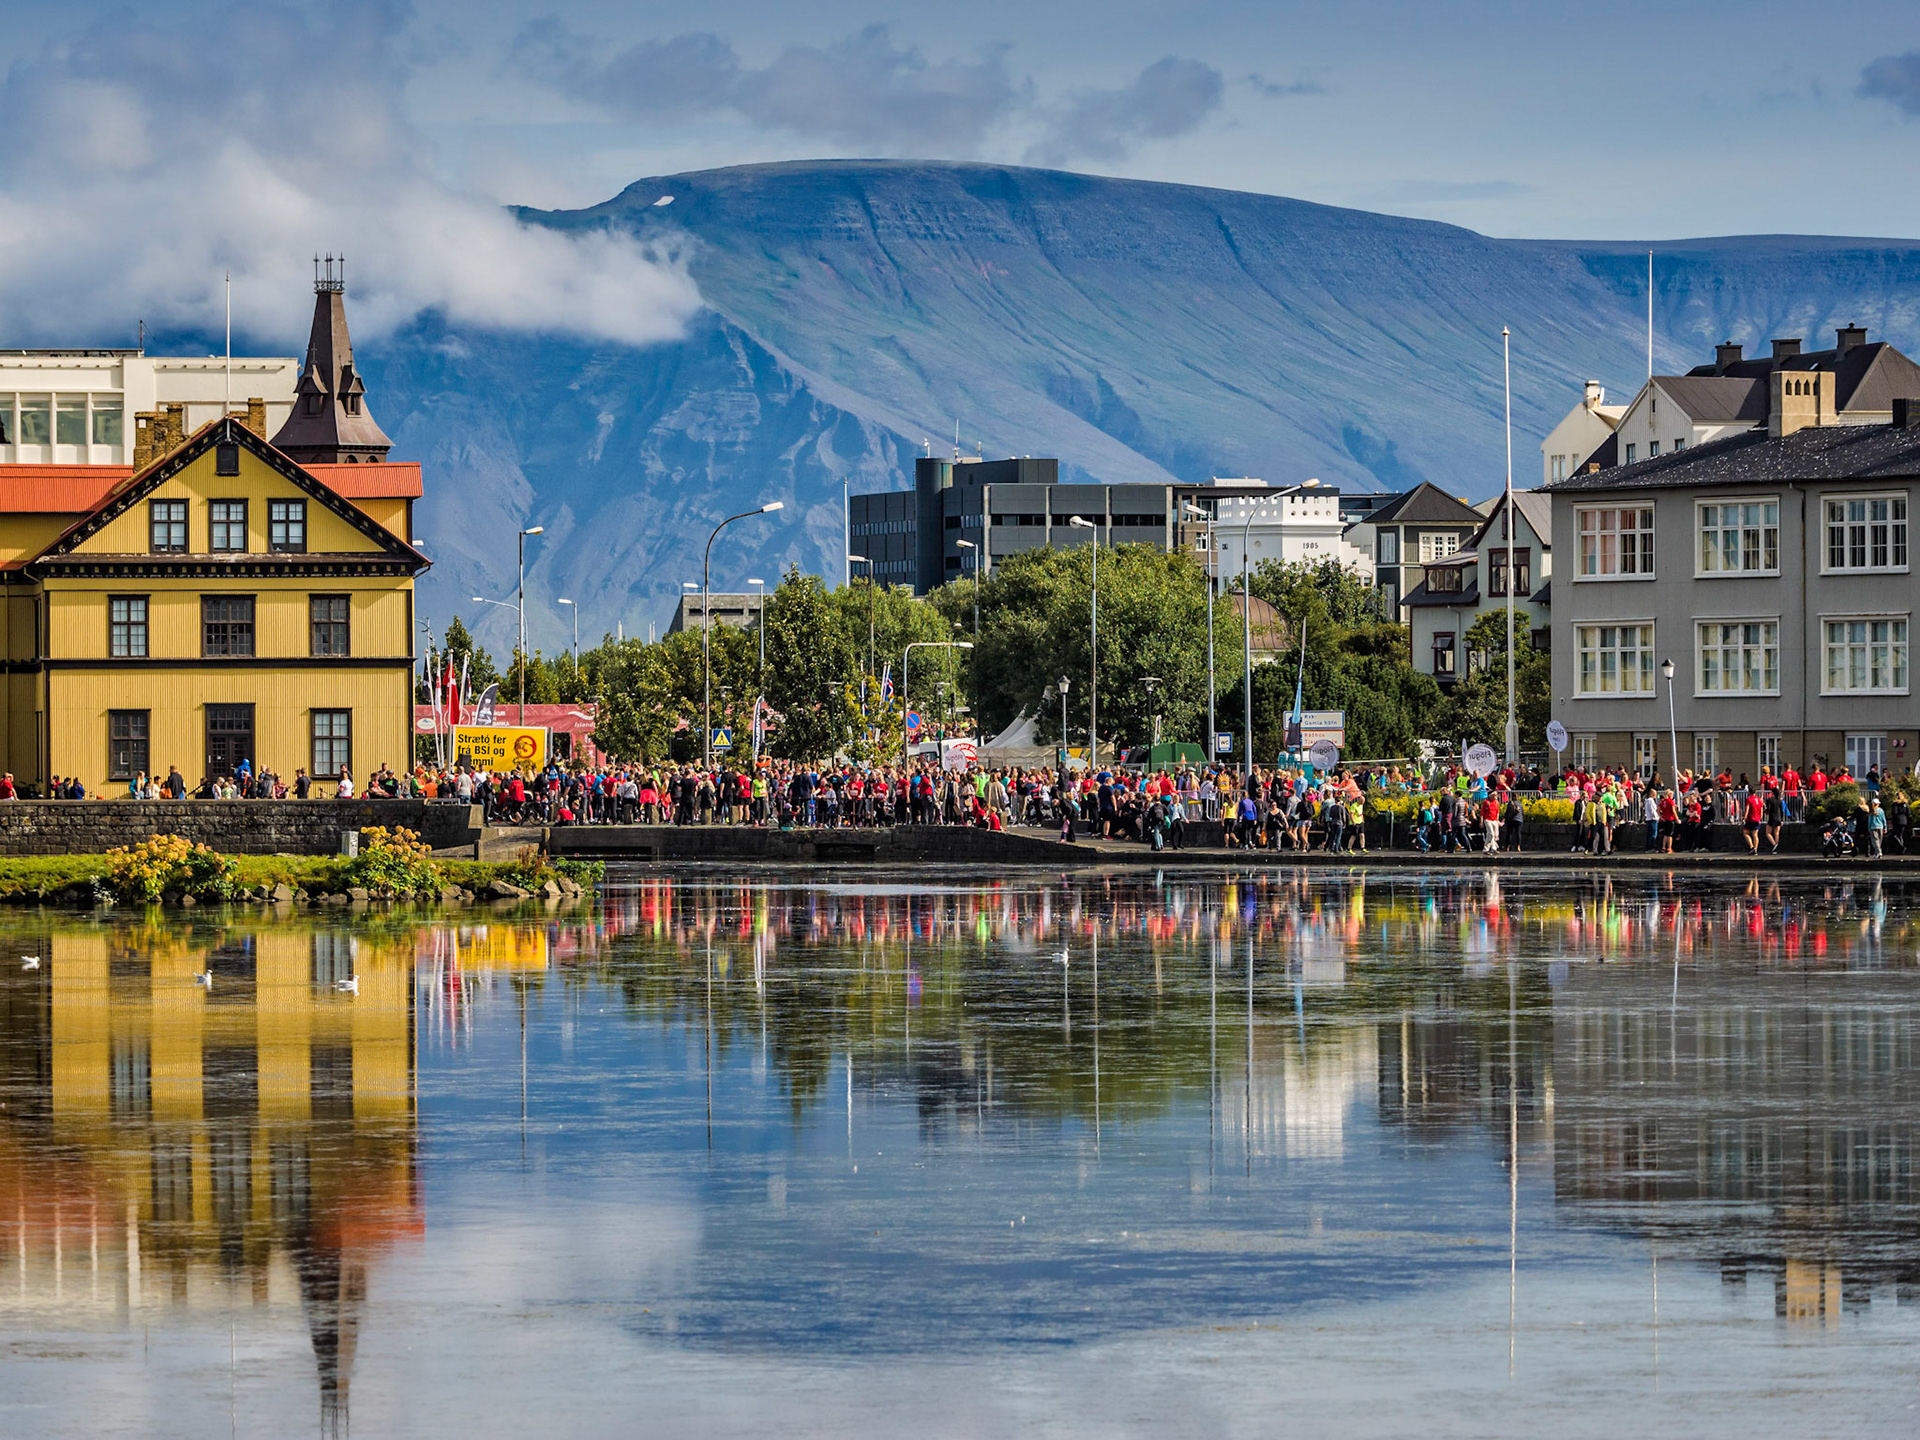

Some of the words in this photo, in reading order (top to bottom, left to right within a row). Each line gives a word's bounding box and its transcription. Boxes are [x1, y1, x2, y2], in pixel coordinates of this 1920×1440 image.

[458, 733, 490, 744] Strætó
[493, 734, 507, 744] fer
[458, 744, 471, 755] frá
[474, 743, 490, 755] BSÍ
[493, 747, 505, 757] og
